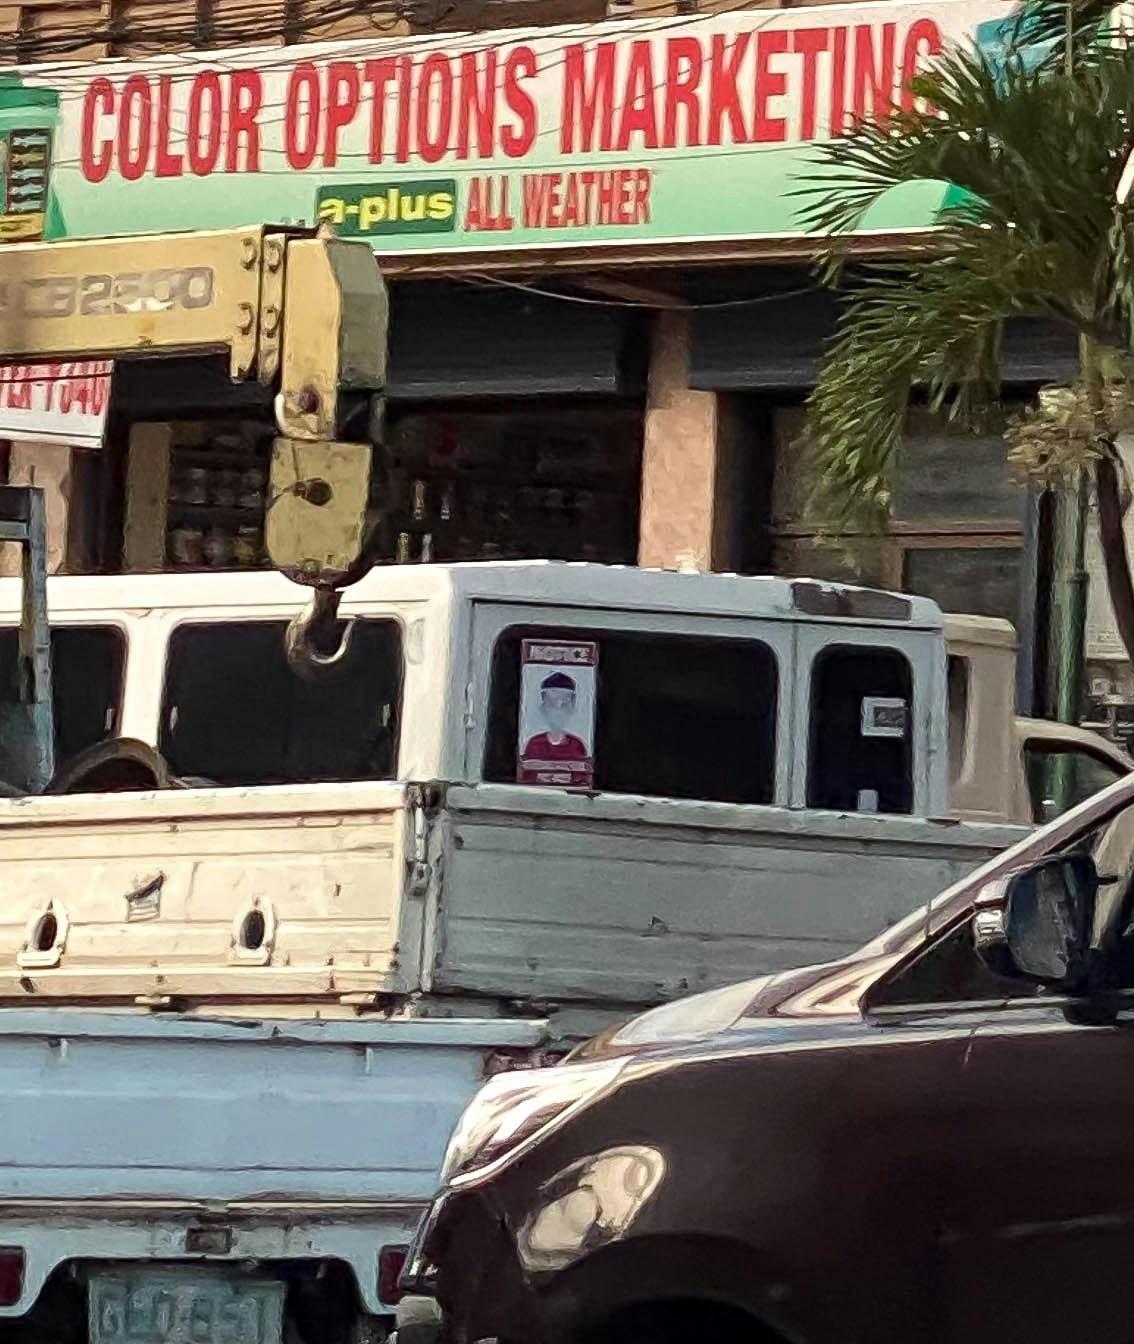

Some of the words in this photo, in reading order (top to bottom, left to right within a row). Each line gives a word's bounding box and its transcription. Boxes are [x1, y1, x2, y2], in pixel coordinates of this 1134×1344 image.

[81, 67, 264, 183] COLOR
[284, 45, 540, 171] OPTIONS
[560, 17, 944, 154] MARKETING
[319, 188, 455, 225] a-plus
[464, 176, 514, 232] ALL
[522, 168, 653, 229] WEATHER
